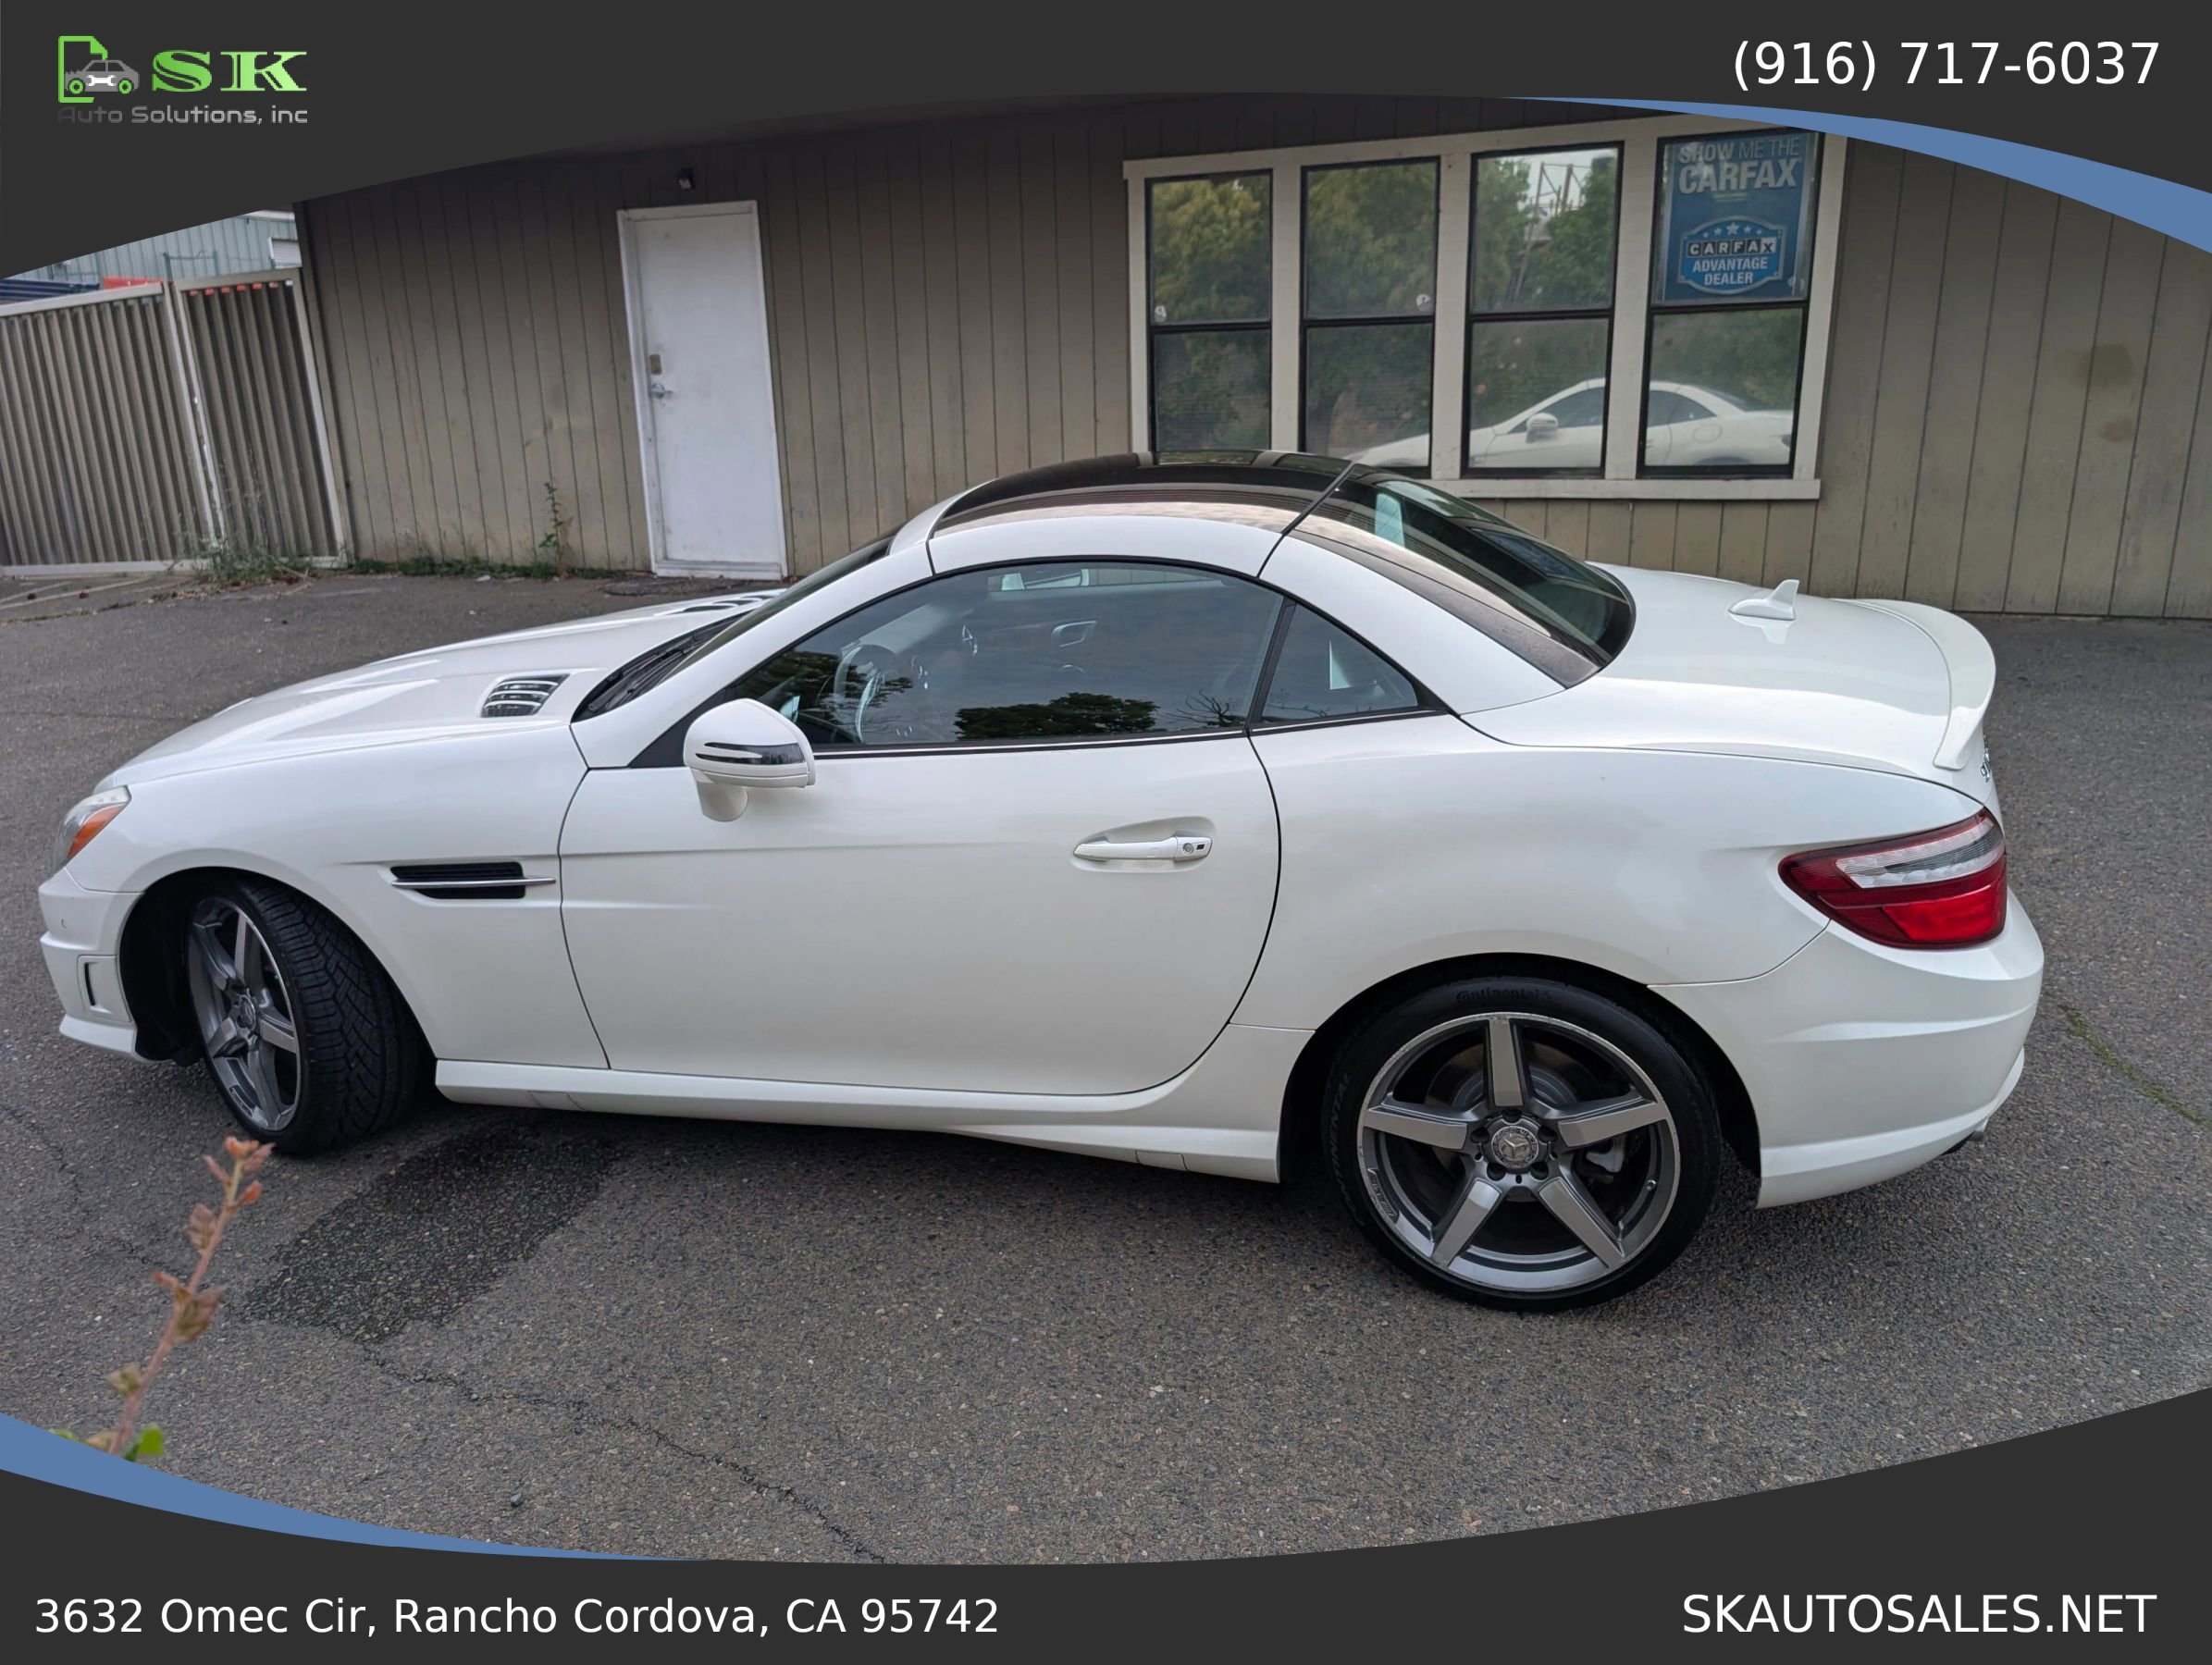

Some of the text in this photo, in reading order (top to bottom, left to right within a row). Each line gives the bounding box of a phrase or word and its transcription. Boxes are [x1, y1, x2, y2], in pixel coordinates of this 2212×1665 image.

[1678, 137, 1800, 164] SHOW ME THE
[1678, 159, 1798, 195] CARFAX
[1687, 239, 1776, 257] CARFAX
[1692, 256, 1769, 273] ADVANTAGE
[1703, 272, 1754, 287] DEALER
